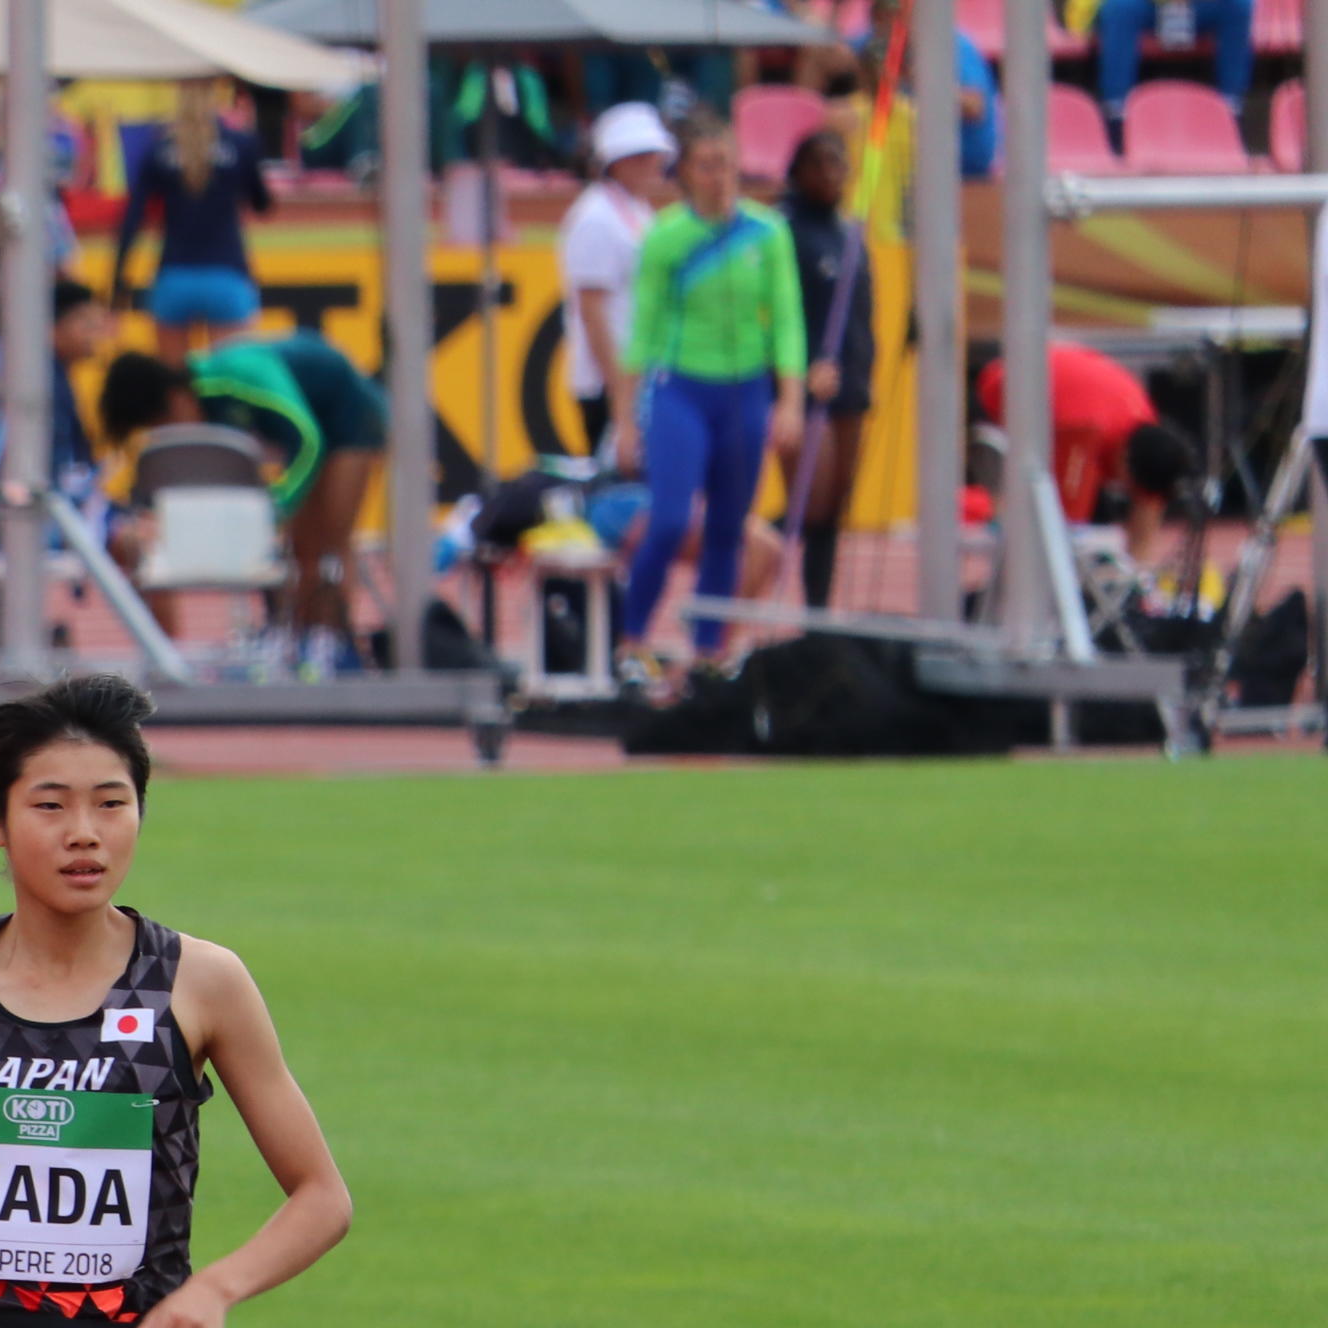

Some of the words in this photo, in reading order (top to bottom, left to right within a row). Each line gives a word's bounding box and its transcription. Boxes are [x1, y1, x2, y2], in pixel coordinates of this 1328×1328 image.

[11, 1098, 67, 1122] KOTI
[19, 1123, 56, 1137] PIZZA
[62, 1251, 113, 1277] 2018
